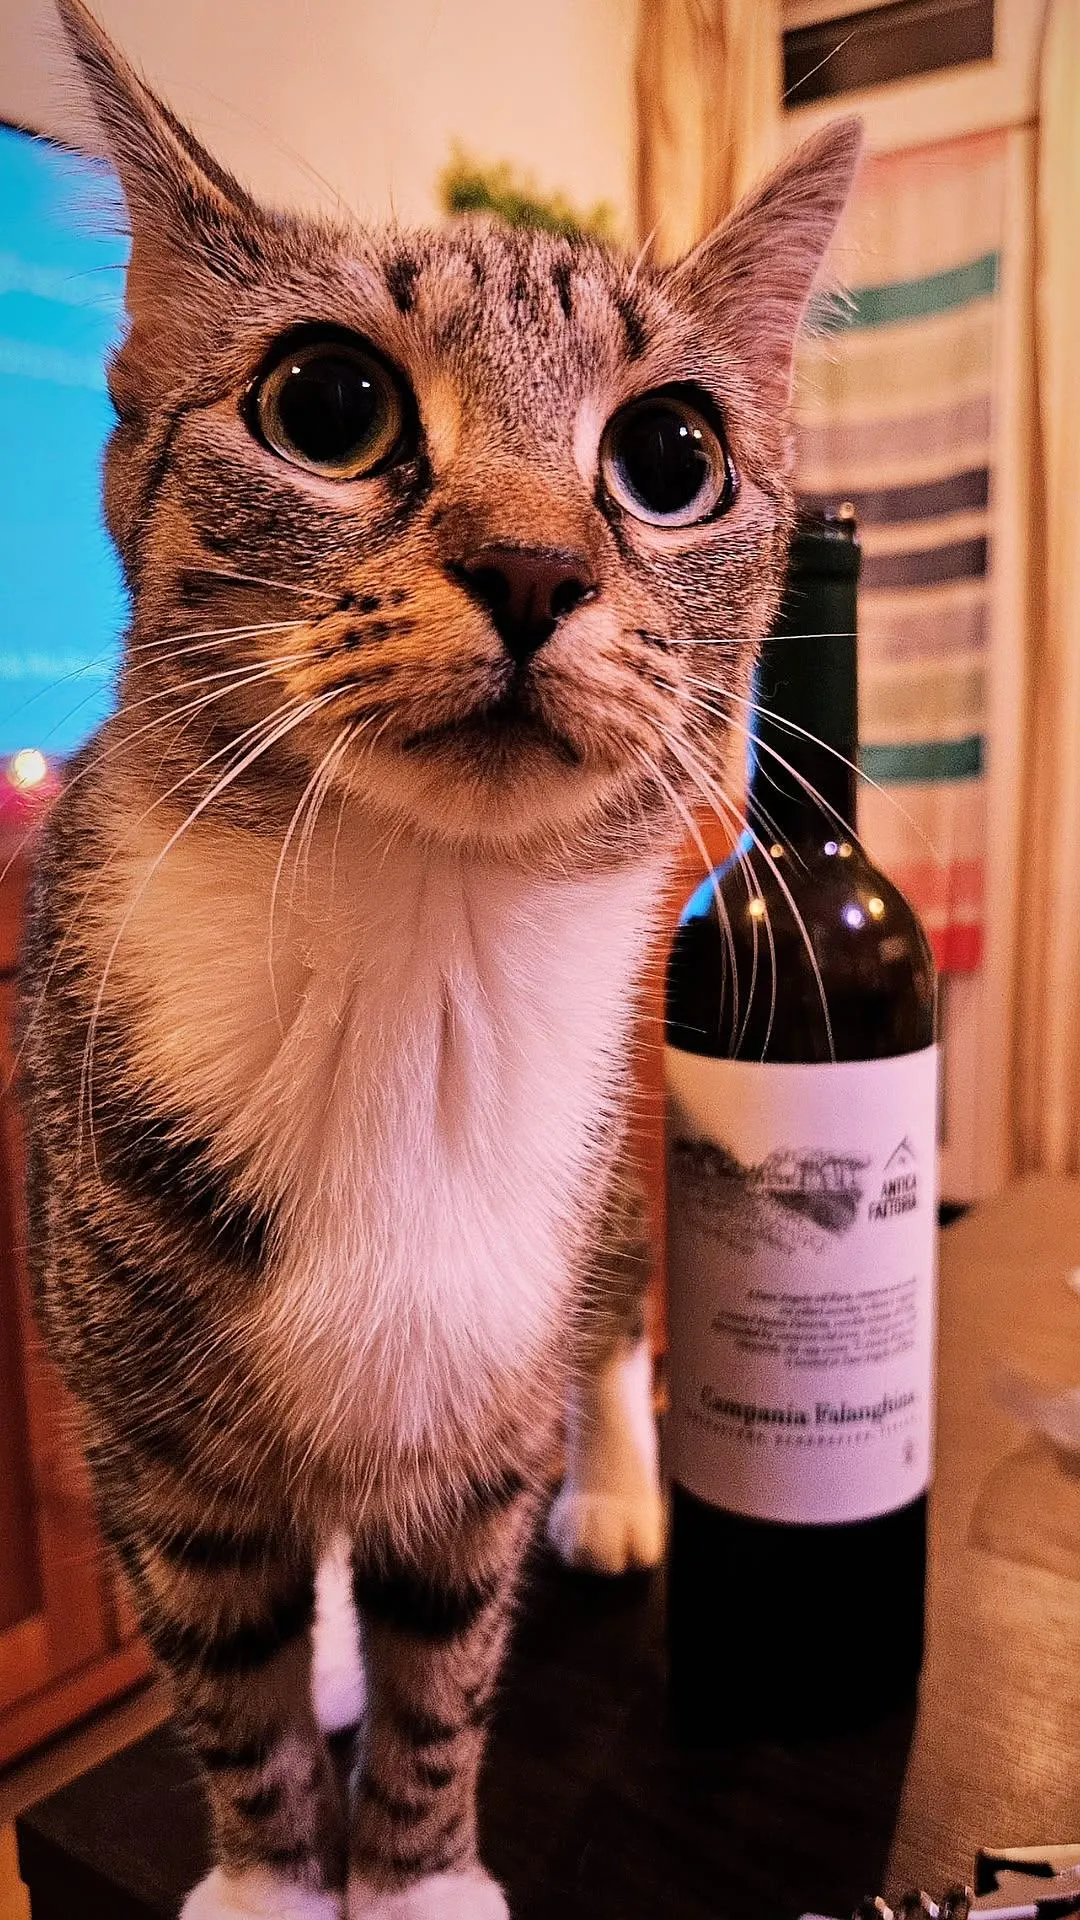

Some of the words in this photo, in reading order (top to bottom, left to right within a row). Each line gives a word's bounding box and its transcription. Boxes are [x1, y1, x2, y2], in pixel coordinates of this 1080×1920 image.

[881, 1174, 917, 1197] ANTICA
[701, 1384, 807, 1426] Campania
[815, 1391, 914, 1426] Falanghina
